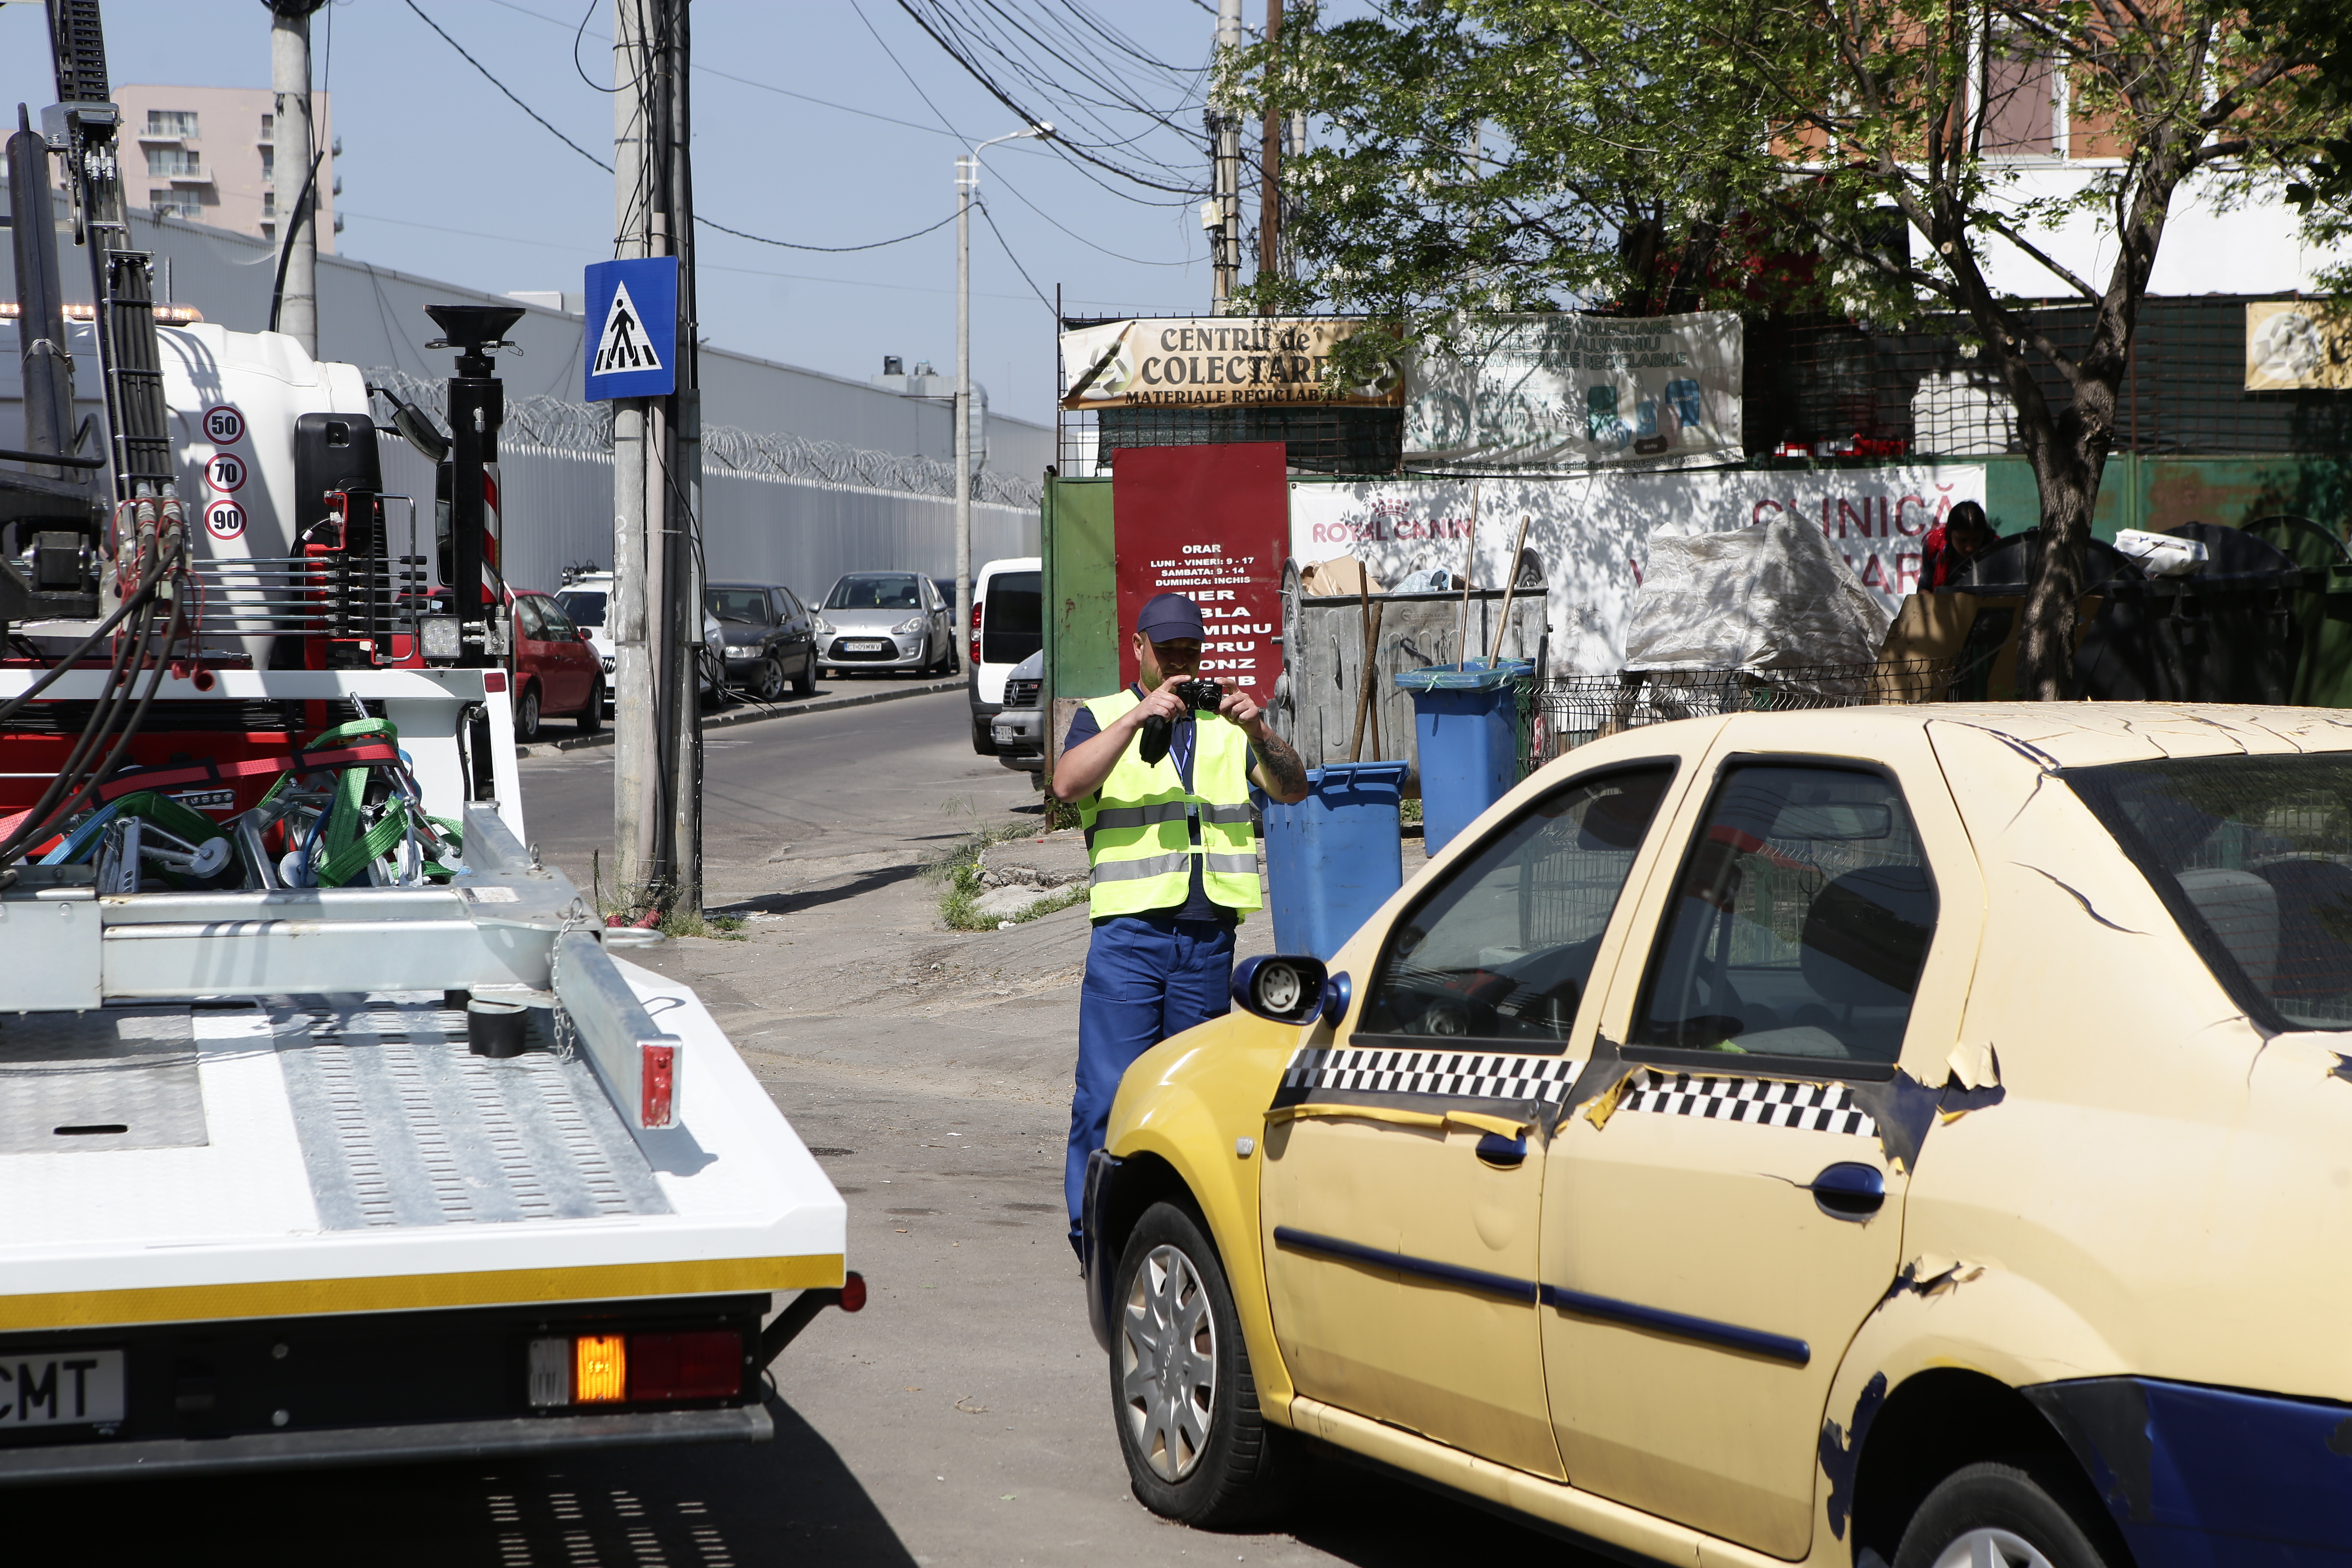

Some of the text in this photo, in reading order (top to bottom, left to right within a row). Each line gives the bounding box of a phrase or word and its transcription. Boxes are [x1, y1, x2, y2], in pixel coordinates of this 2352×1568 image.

[1548, 317, 1571, 332] DE
[1576, 318, 1672, 336] COLECTARE
[1161, 328, 1311, 352] CENTRU de
[1482, 334, 1660, 353] DOZE DIN ALUMINIU
[1483, 352, 1580, 368] MATERIALE
[1583, 352, 1687, 370] RECICLABILE
[1126, 390, 1225, 404] MATERIALE
[212, 416, 237, 435] 50
[1435, 459, 1450, 468] din
[1452, 460, 1496, 469] aluminiu
[1498, 462, 1519, 471] este
[1522, 461, 1547, 471] 100%
[1668, 455, 1698, 465] DOZA
[215, 463, 237, 483] 70
[1753, 483, 1954, 538] CINICĂ
[214, 510, 239, 529] 90
[1313, 518, 1472, 543] ROYAL CANIN
[1182, 544, 1221, 554] ORAR
[1155, 576, 1251, 586] DUMINICA: INCHIS
[1161, 568, 1213, 577] SAMBATA:
[1200, 606, 1251, 618] BLA
[1203, 623, 1272, 635] MINU
[1200, 641, 1255, 653] PRU
[1199, 658, 1256, 671] ONZ
